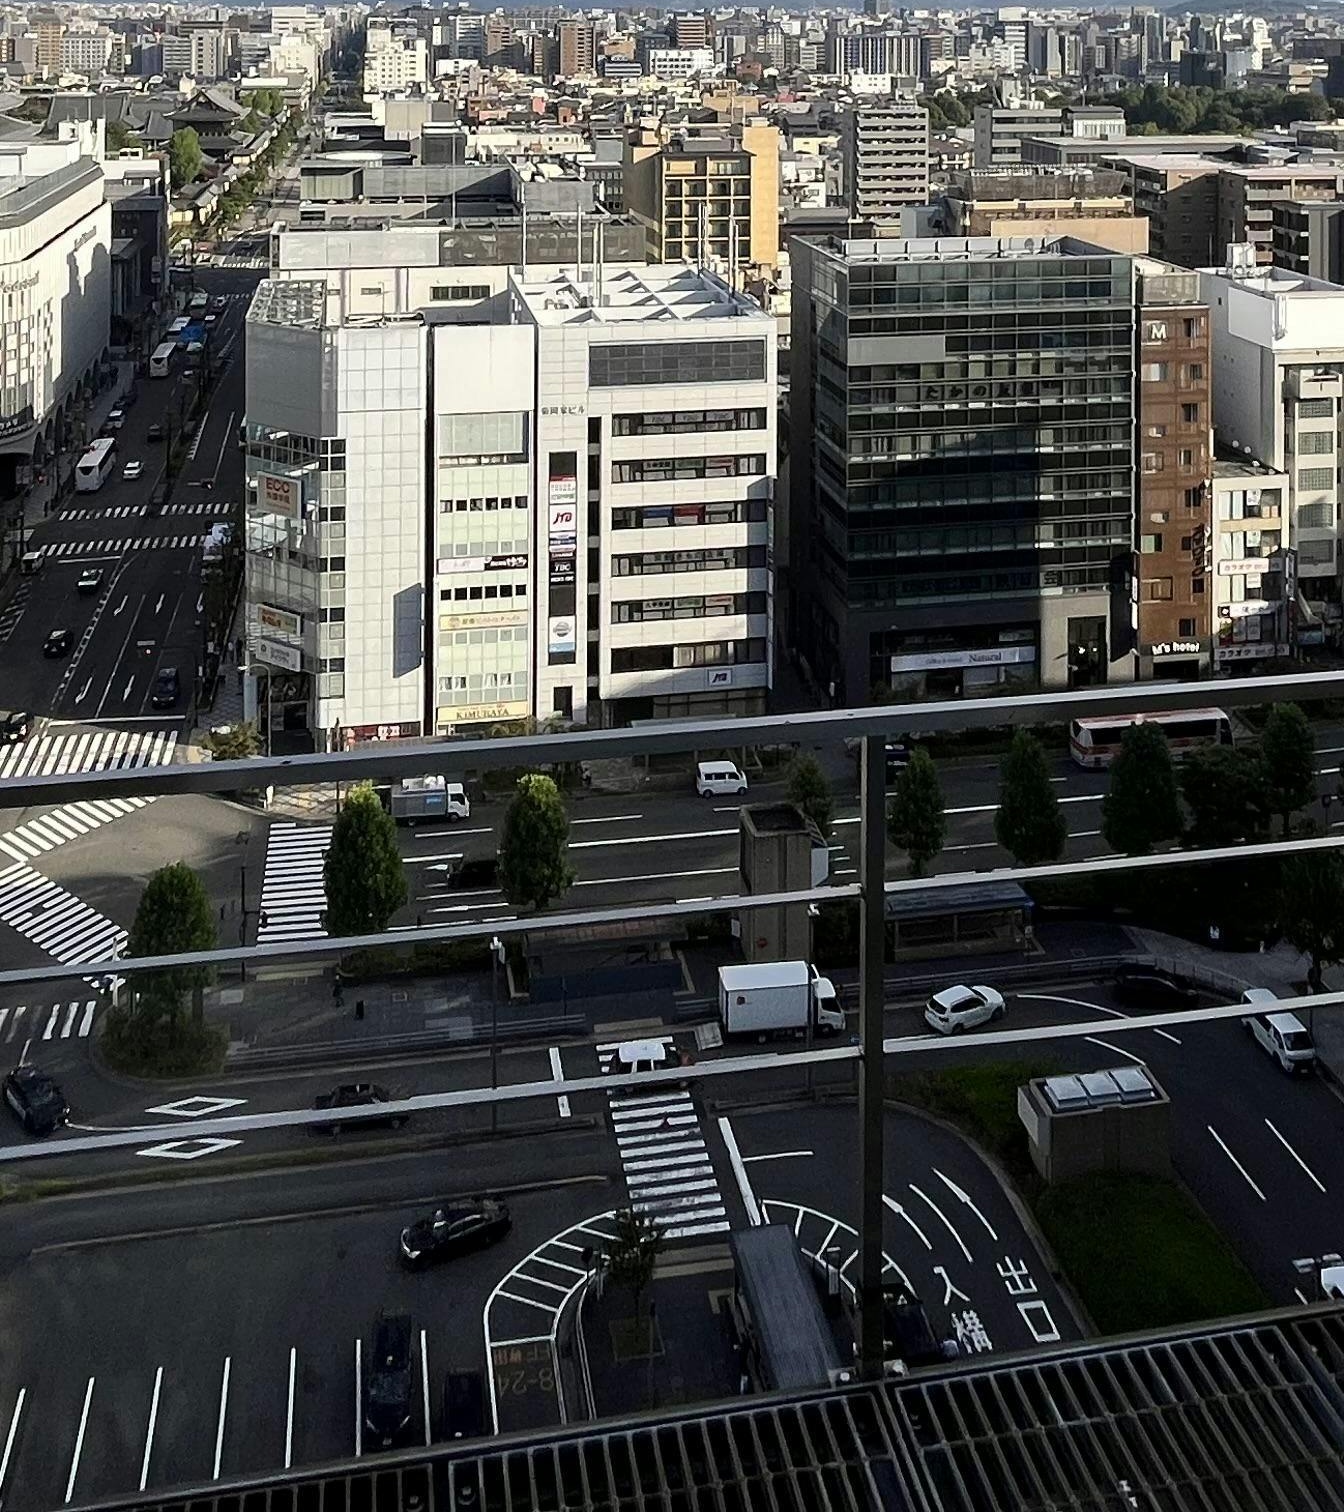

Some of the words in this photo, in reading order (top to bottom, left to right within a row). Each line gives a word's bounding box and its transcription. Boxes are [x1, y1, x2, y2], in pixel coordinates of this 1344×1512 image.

[1151, 324, 1167, 339] M
[266, 477, 290, 494] ECC
[1172, 641, 1200, 653] hotel
[968, 652, 1002, 663] Natural
[456, 709, 509, 720] KIMURAYA
[996, 1256, 1061, 1343] 出口
